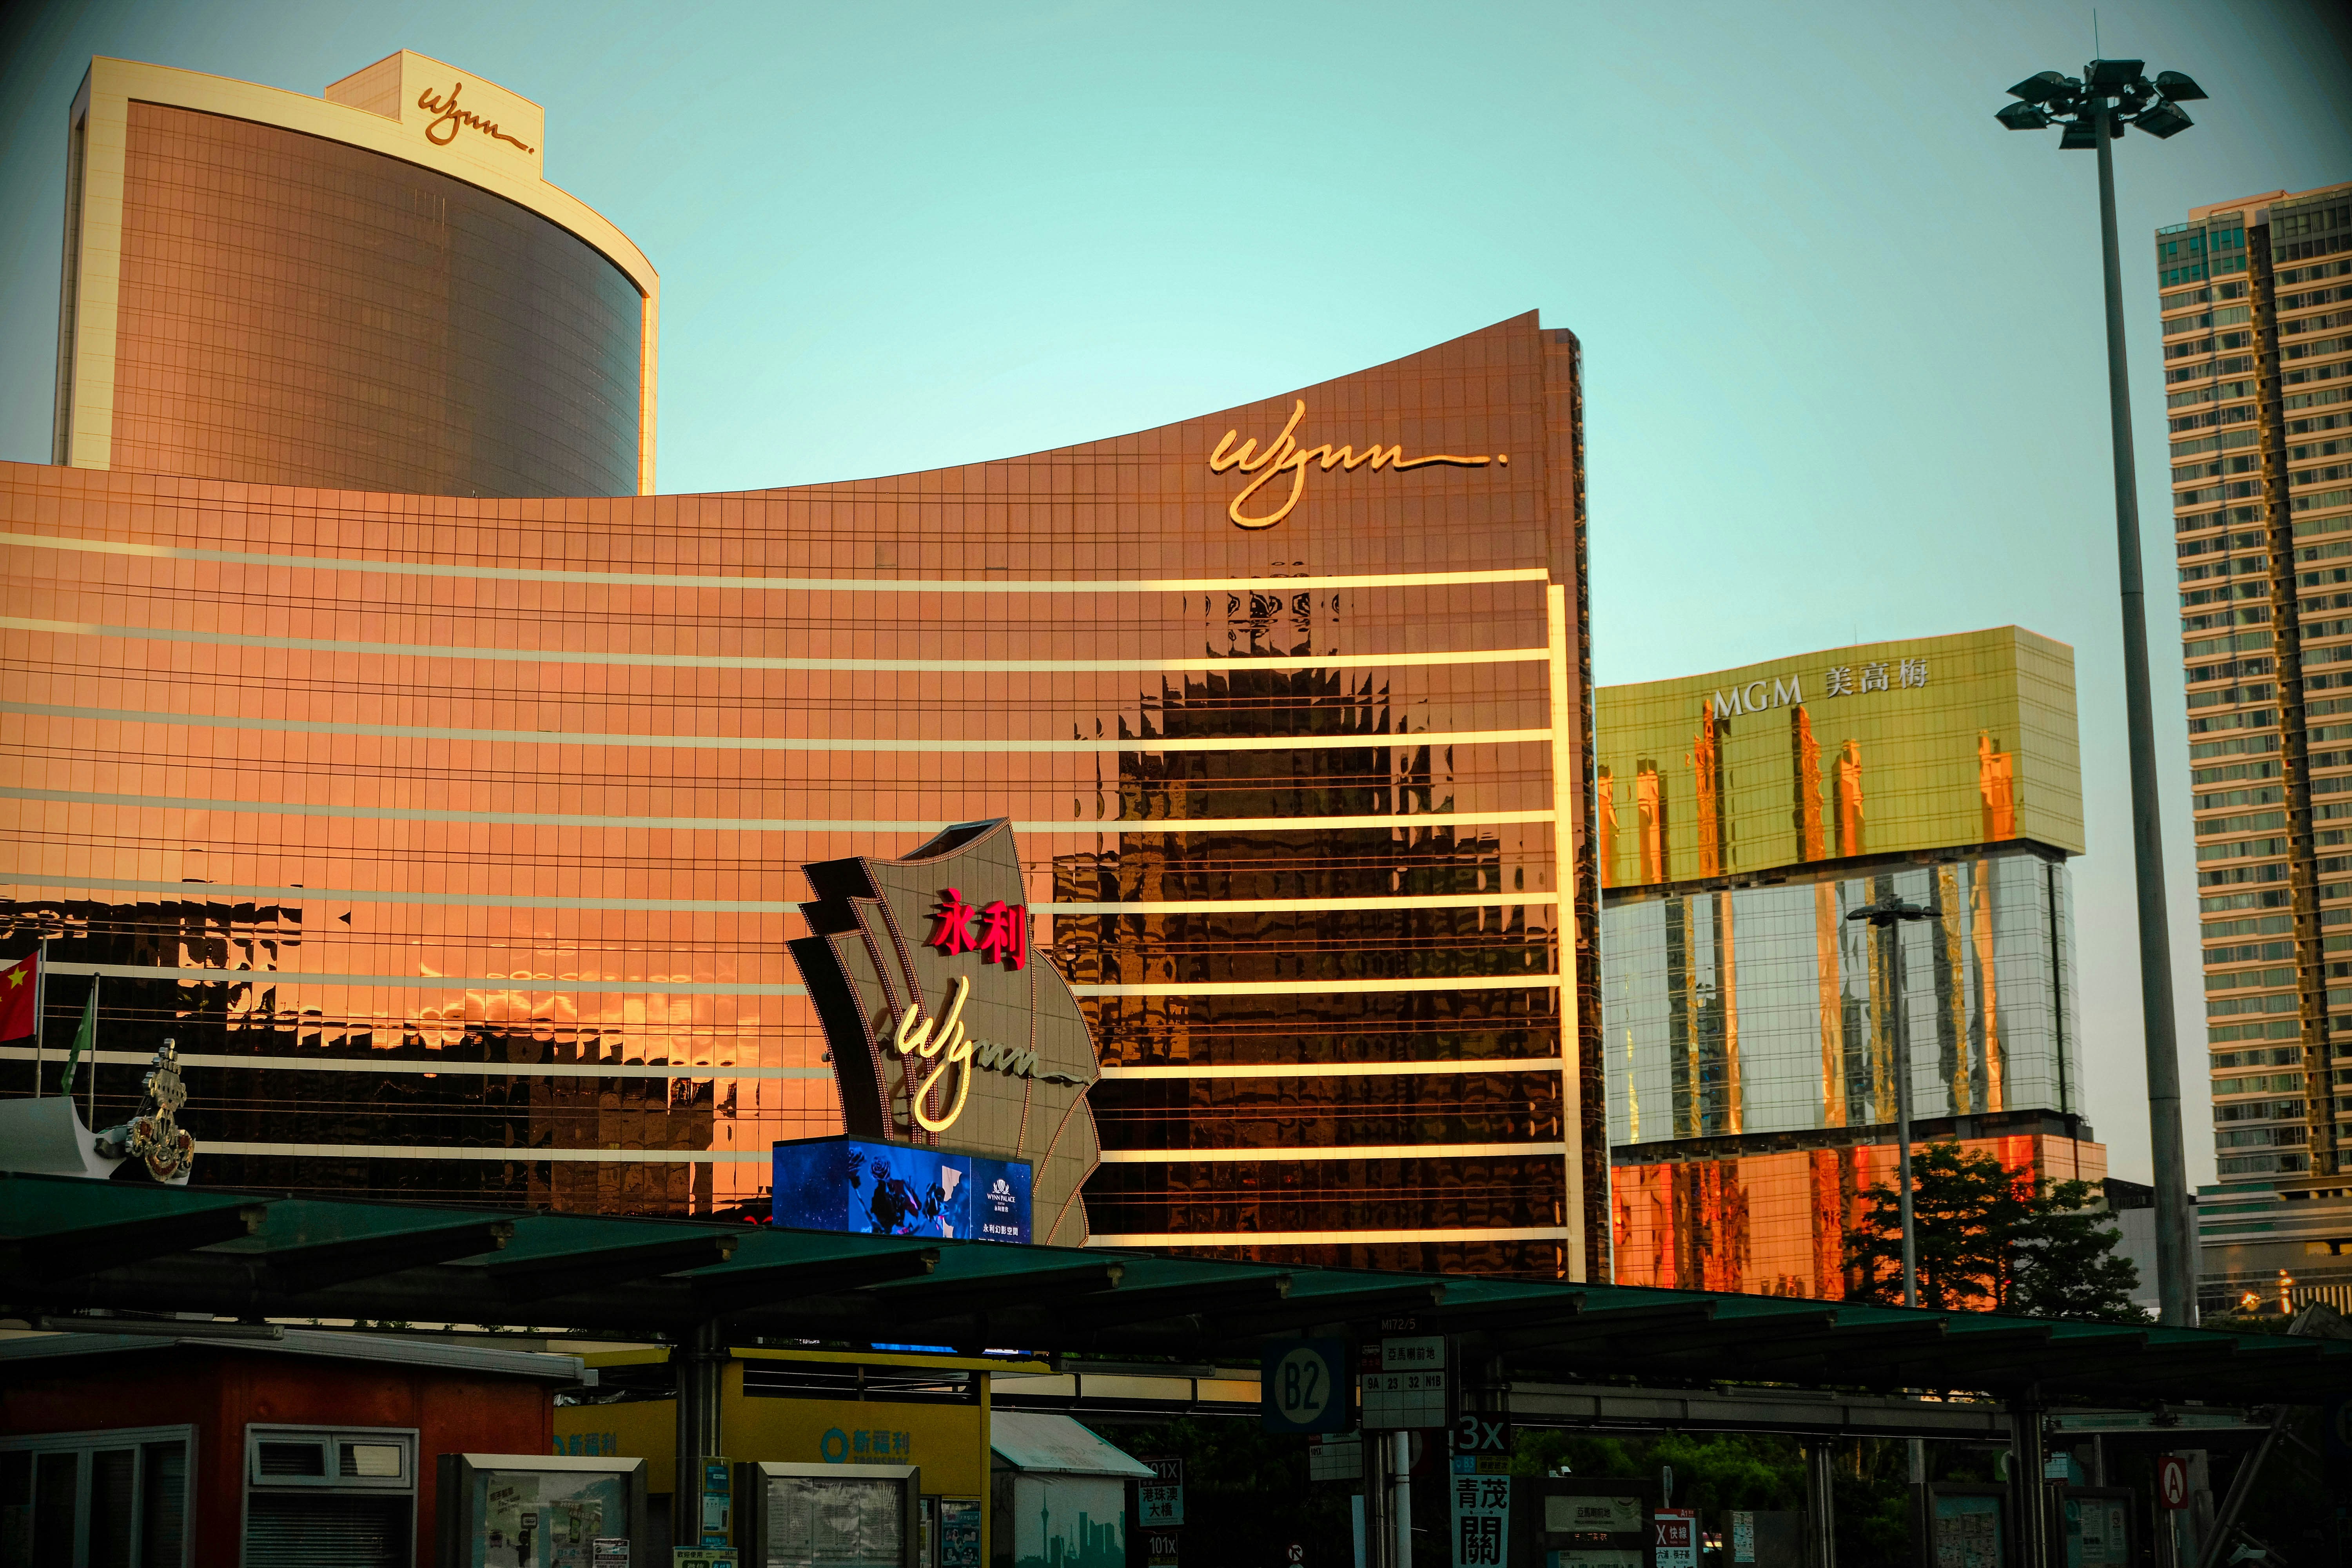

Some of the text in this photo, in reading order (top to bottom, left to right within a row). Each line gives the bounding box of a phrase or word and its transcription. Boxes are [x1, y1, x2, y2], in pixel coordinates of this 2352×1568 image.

[1826, 658, 1928, 699] 美高梅
[1713, 674, 1805, 720] MGM
[935, 887, 1026, 971] 永利
[1381, 1318, 1416, 1330] M172/5
[1388, 1347, 1435, 1361] 亞馬喇前地
[1285, 1361, 1319, 1410] B2
[1368, 1376, 1441, 1389] 9A 23 32 N1B
[1145, 1462, 1178, 1479] 01X
[2168, 1467, 2180, 1499] A
[1143, 1487, 1178, 1502] 港珠澳
[1456, 1479, 1507, 1508] 青茂
[1149, 1503, 1172, 1517] 大橋
[1669, 1526, 1687, 1539] 快線
